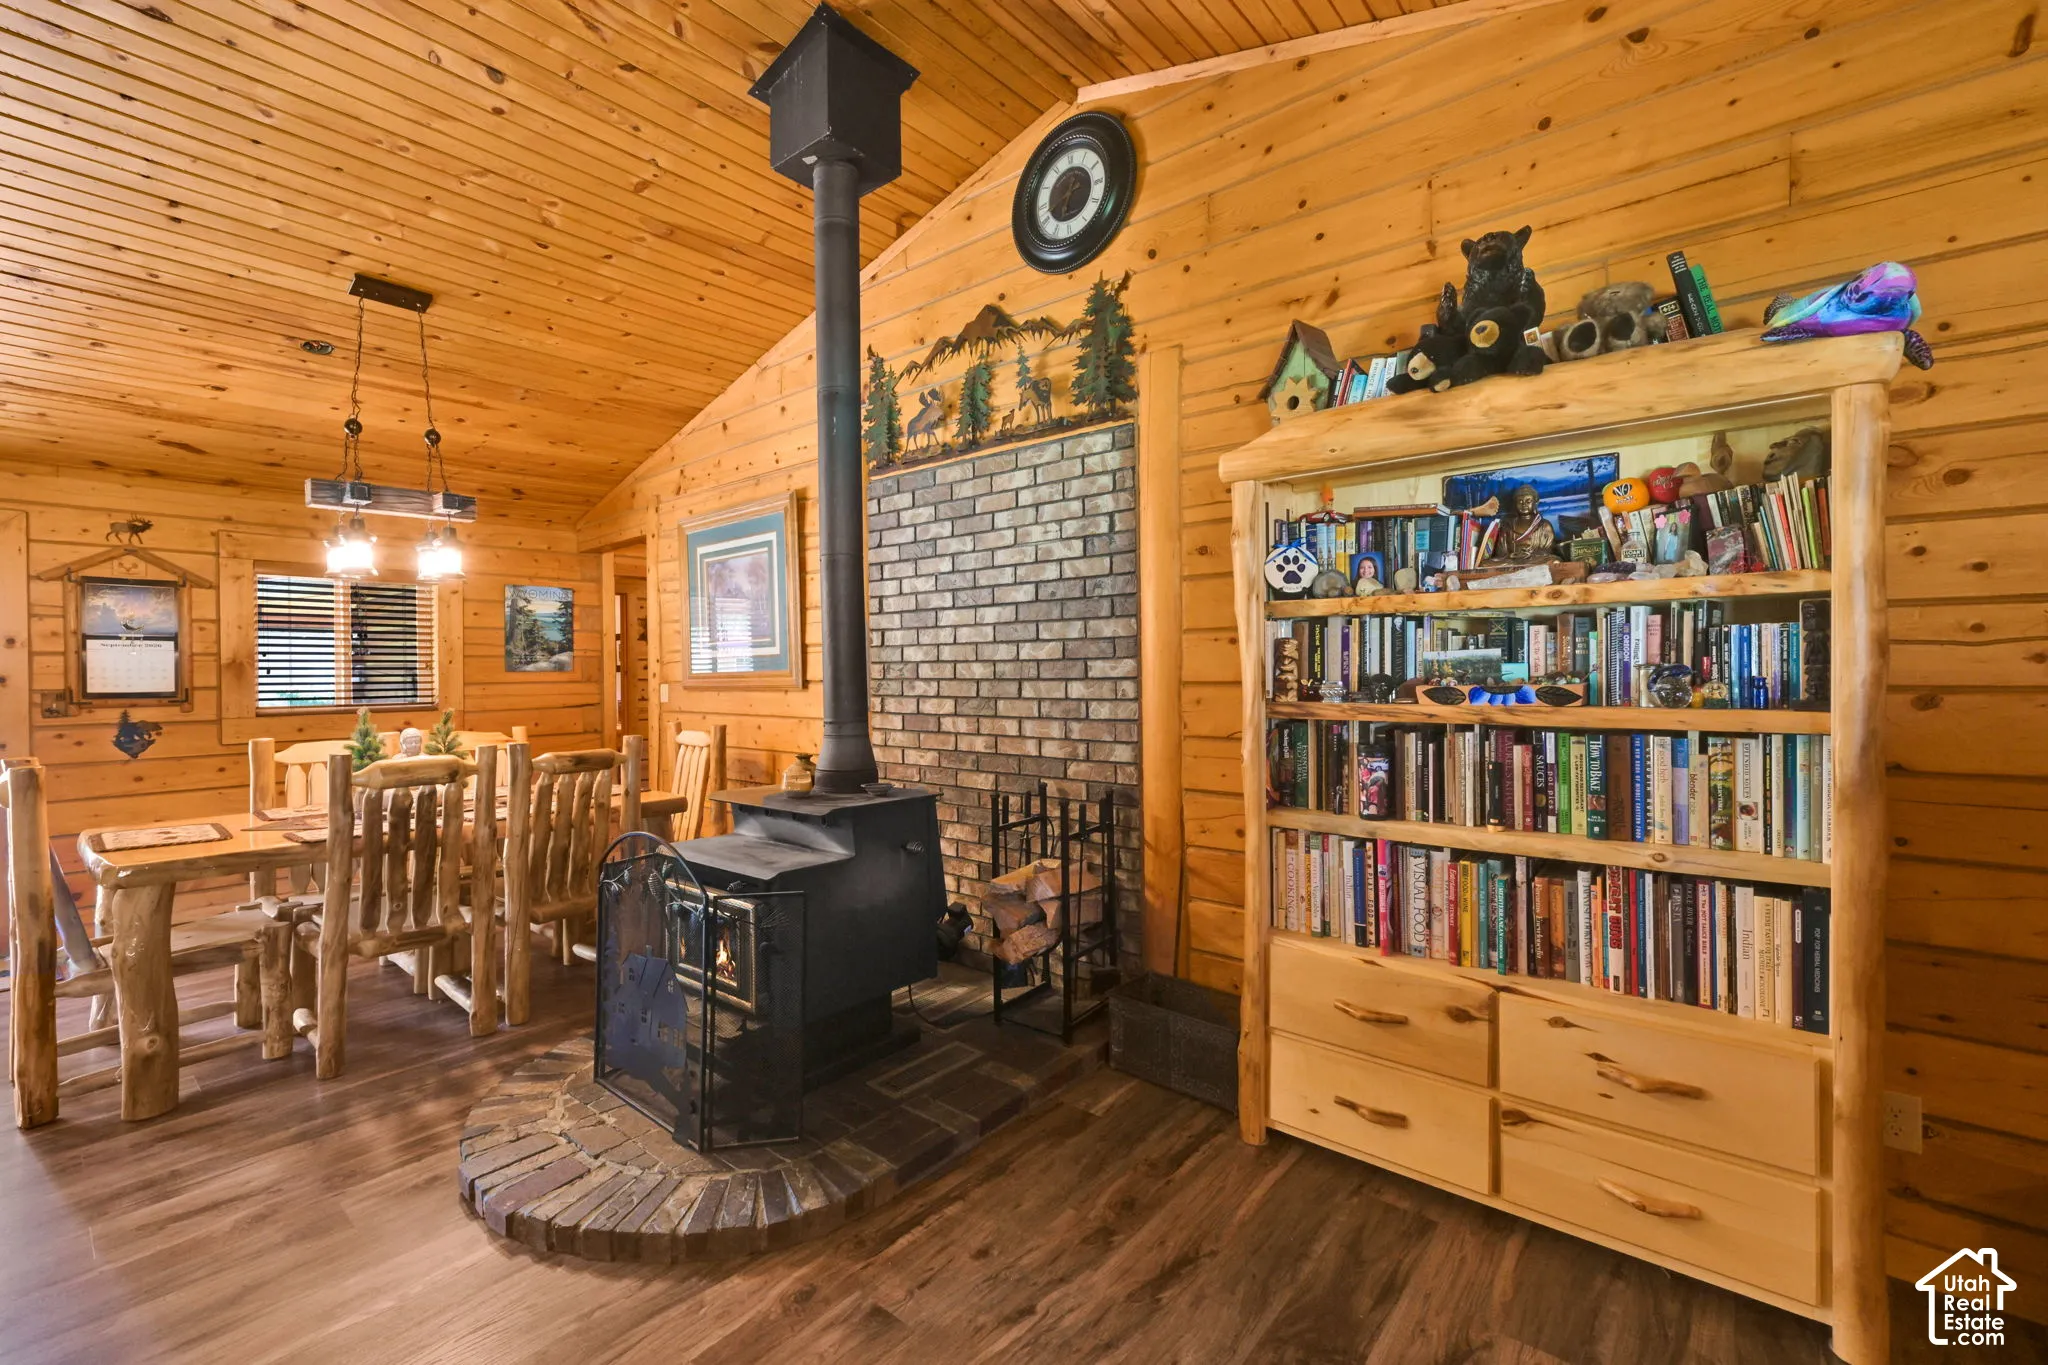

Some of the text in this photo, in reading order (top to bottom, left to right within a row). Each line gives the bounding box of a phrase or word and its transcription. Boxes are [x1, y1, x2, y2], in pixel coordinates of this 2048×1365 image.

[1697, 277, 1708, 291] THE
[1703, 294, 1714, 314] REAL
[1369, 362, 1379, 386] PRINCE
[508, 588, 570, 601] WYOMING
[1536, 754, 1545, 788] SAUCES
[1659, 750, 1668, 766] good
[1660, 768, 1668, 783] herb
[1287, 863, 1295, 913] COOKING
[1414, 862, 1425, 942] VISUAL FOOD
[1672, 895, 1682, 922] PASTA
[1742, 929, 1752, 960] Indian
